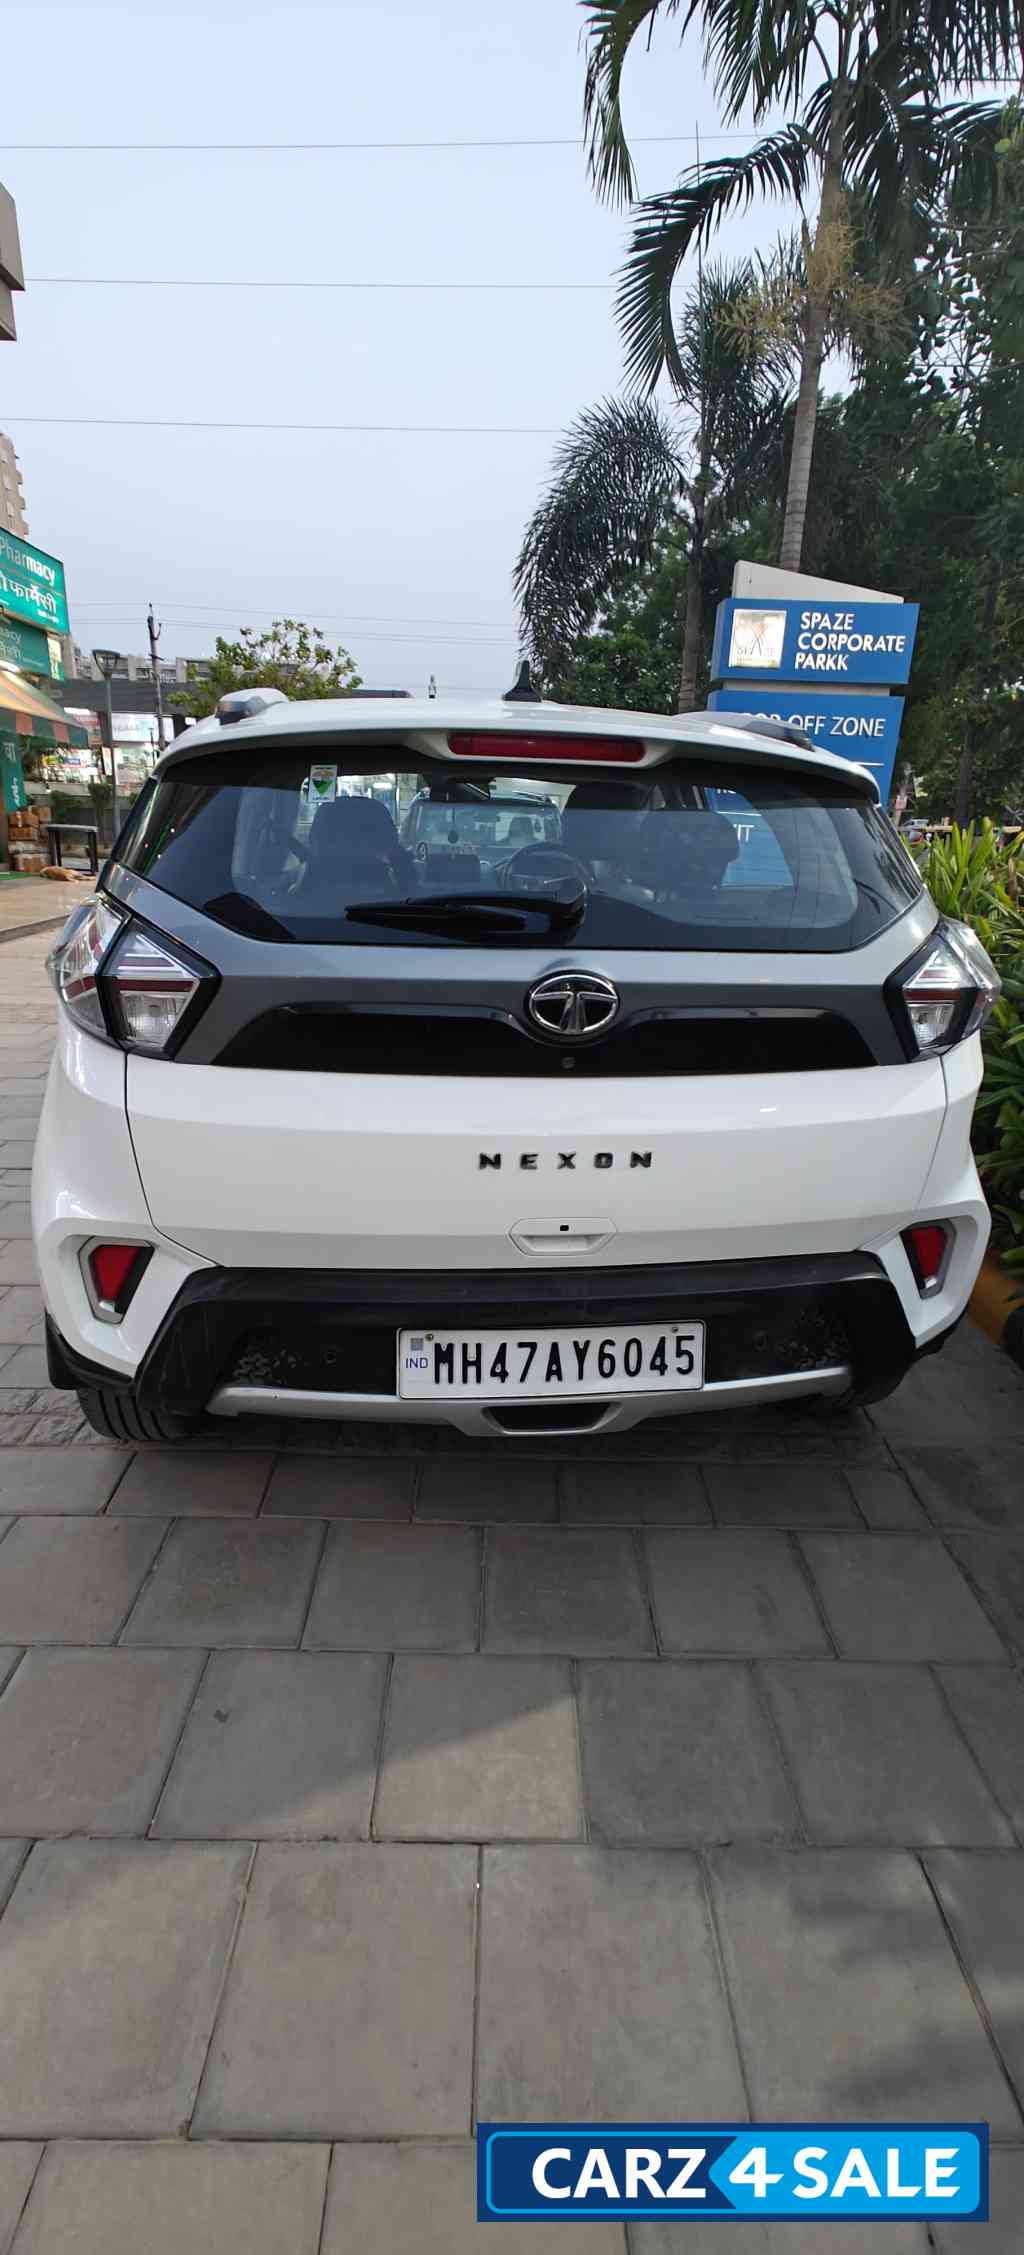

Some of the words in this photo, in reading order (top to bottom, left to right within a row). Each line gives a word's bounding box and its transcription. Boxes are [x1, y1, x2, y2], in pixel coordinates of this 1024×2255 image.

[0, 536, 55, 586] Pharmacy
[800, 611, 855, 631] SPAZE
[797, 632, 906, 653] CORPORATE
[794, 653, 849, 671] PARKK
[829, 716, 886, 737] ZONE
[478, 1151, 653, 1171] NEXON
[405, 1356, 429, 1370] IND
[433, 1335, 696, 1385] MH47AY6045
